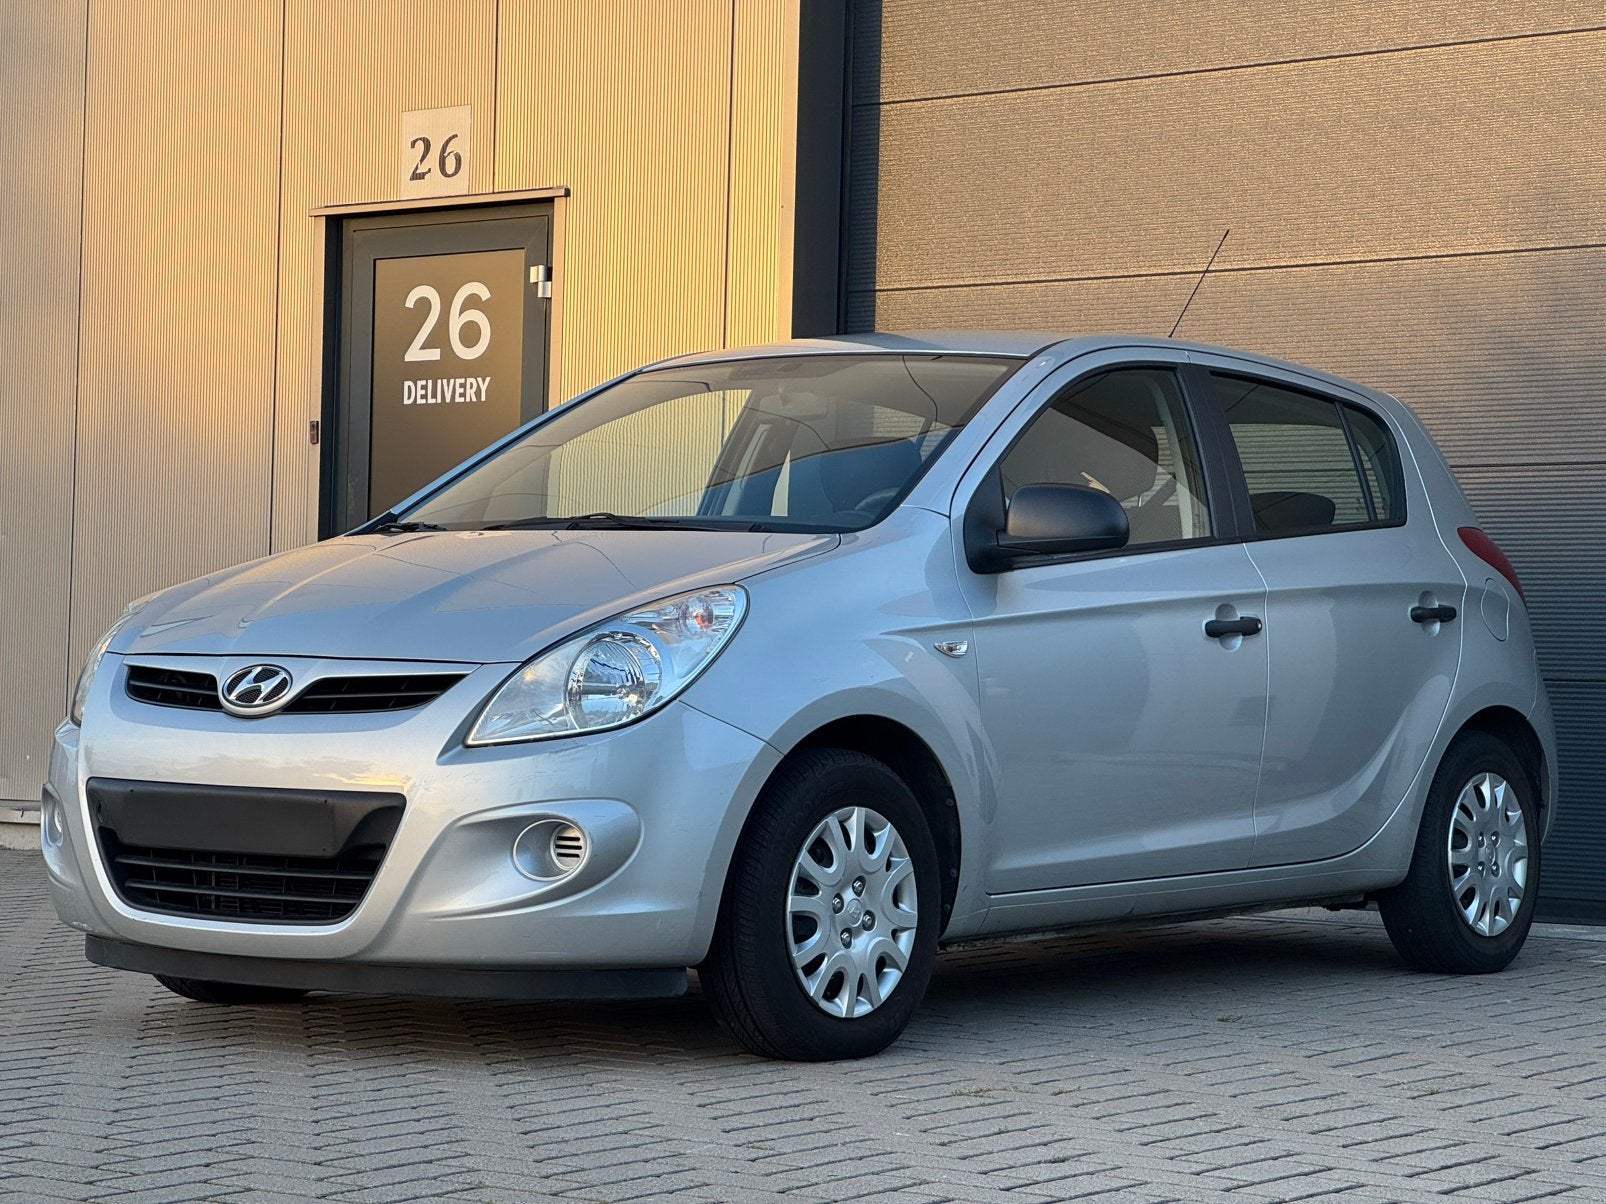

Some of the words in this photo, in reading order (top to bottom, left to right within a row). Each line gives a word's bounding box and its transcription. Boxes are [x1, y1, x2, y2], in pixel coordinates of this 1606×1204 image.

[409, 133, 462, 181] 26
[404, 281, 491, 361] 26
[403, 376, 491, 405] DELIVERY
